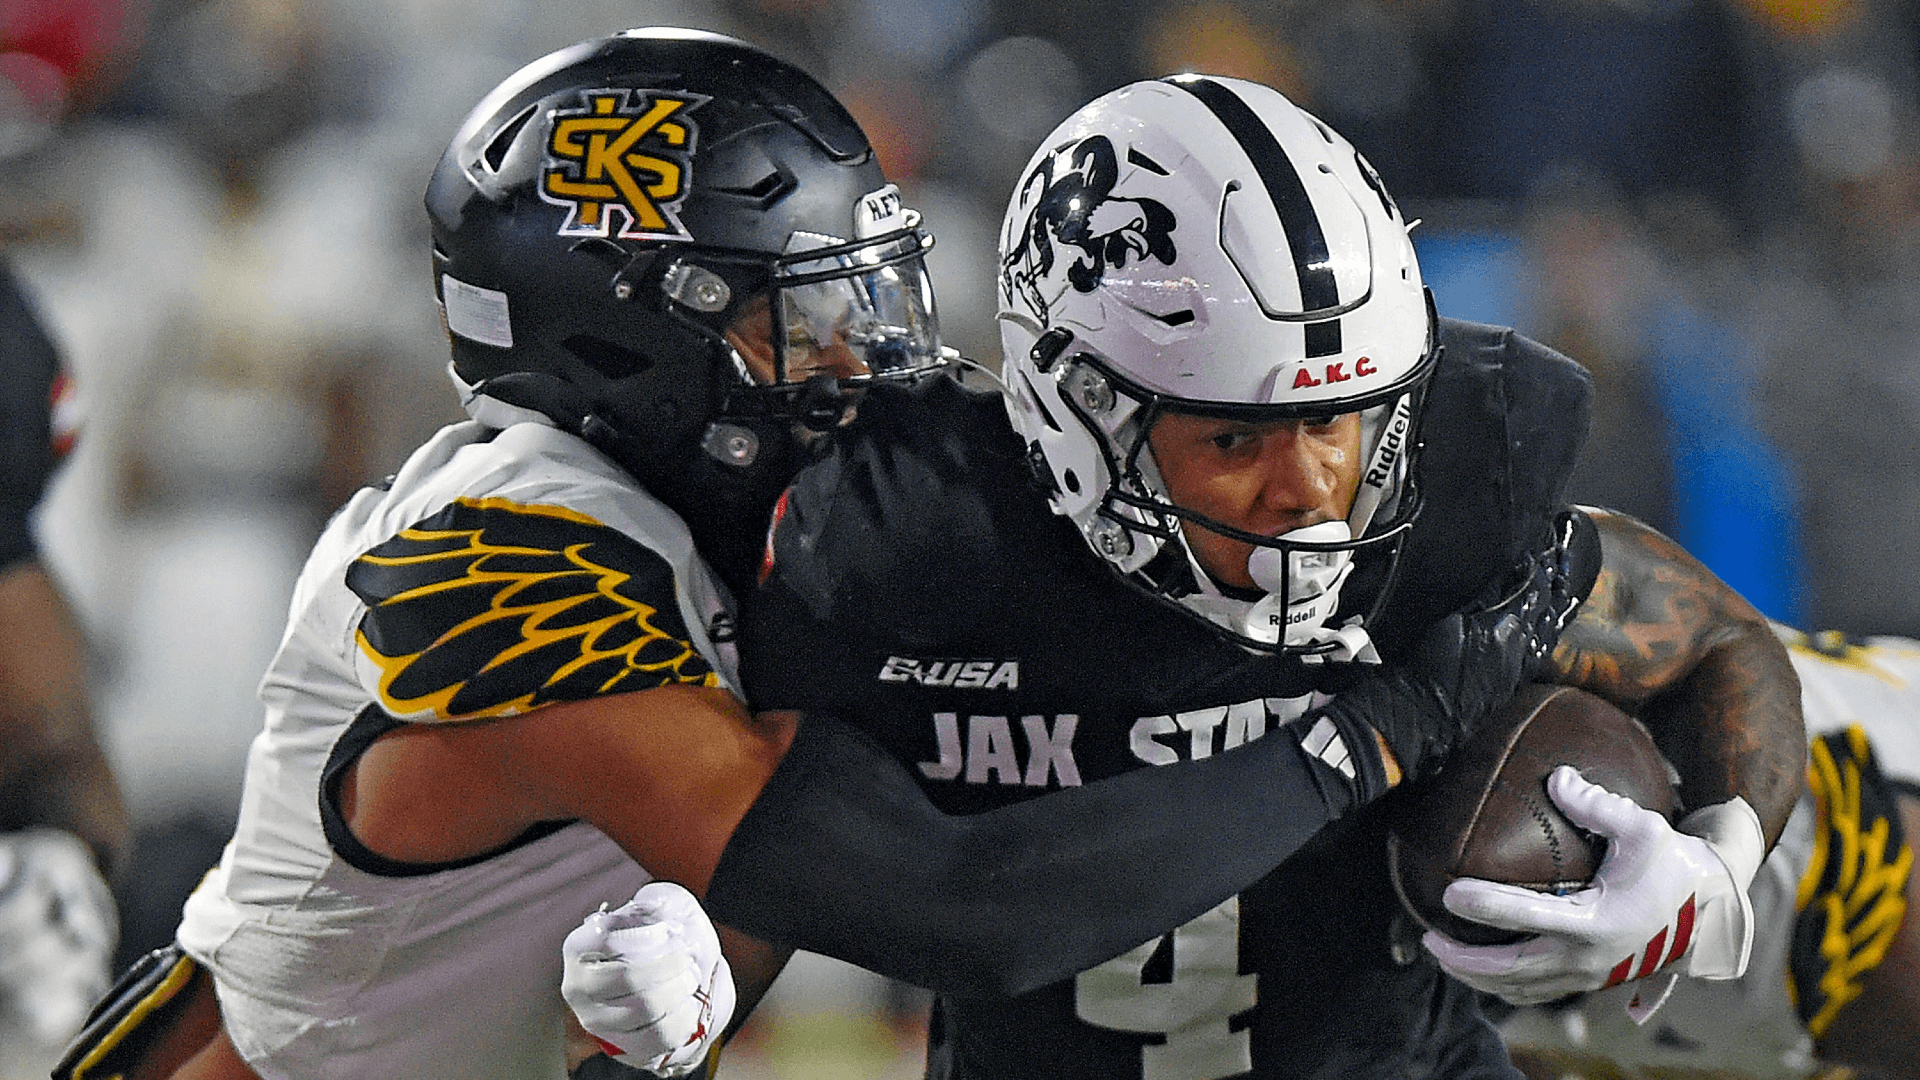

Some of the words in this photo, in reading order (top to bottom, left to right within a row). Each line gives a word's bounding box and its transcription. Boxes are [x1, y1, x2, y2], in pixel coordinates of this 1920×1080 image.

[1365, 403, 1412, 489] Riddell
[1268, 606, 1317, 626] Rddell
[917, 711, 1083, 787] JAX
[1074, 893, 1259, 1080] 4
